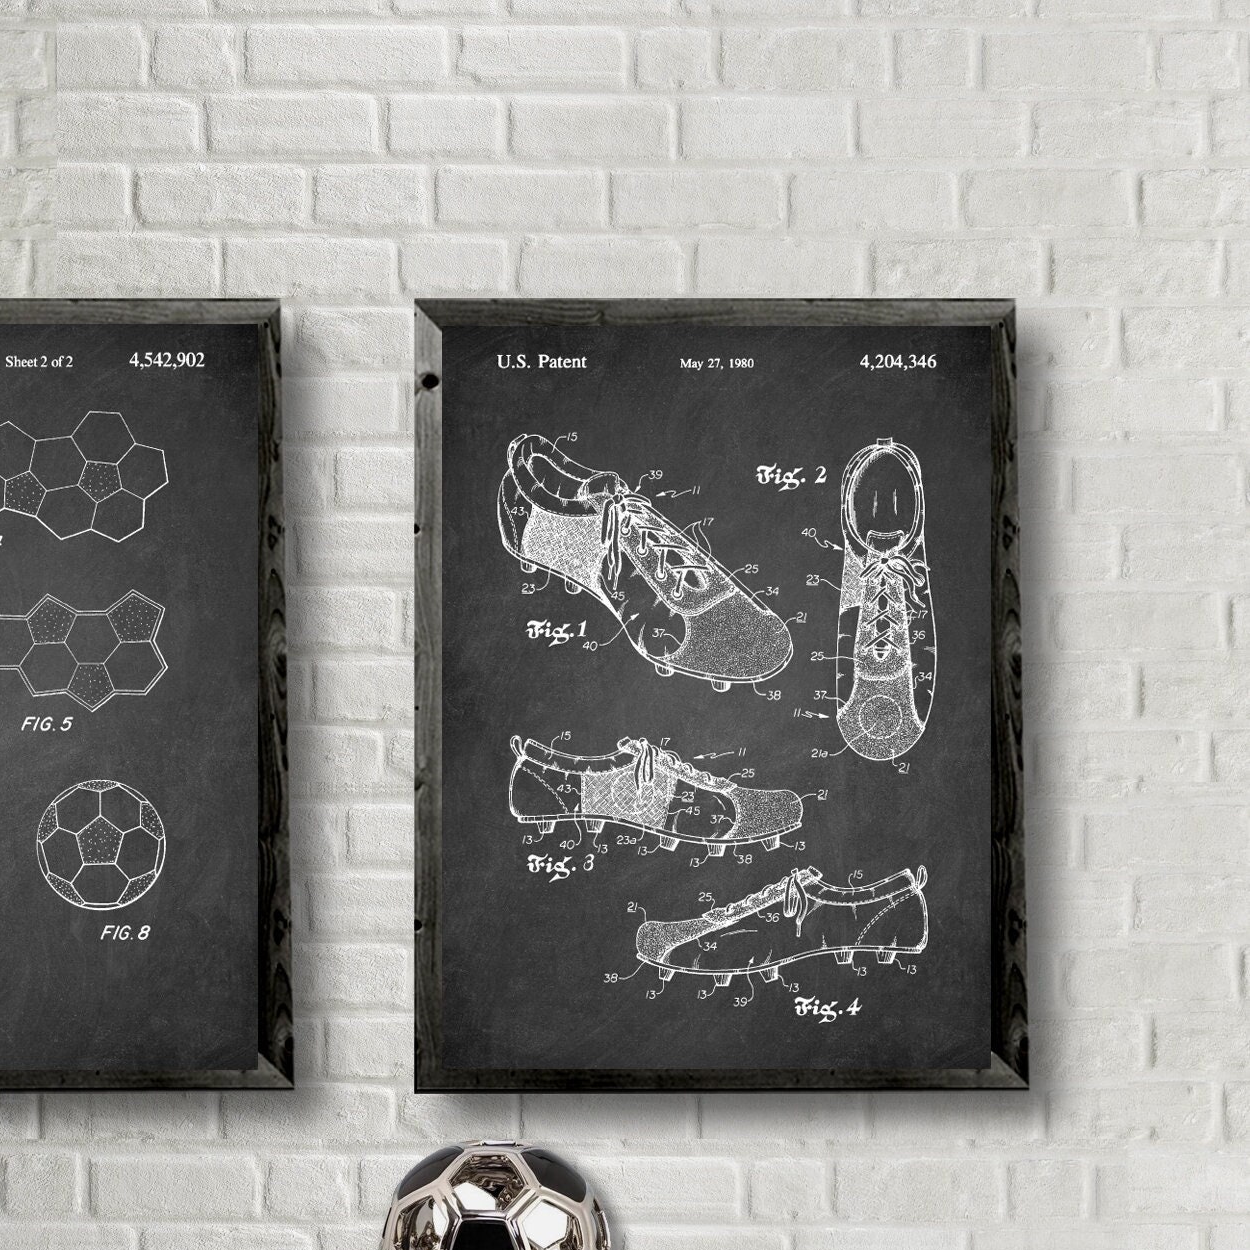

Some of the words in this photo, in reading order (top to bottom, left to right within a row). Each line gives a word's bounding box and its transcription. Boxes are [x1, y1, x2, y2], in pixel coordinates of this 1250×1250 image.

[5, 355, 38, 368] Sheet
[40, 355, 48, 368] 2
[51, 355, 63, 368] of
[64, 356, 74, 368] 2
[129, 352, 205, 370] 4,542,902
[497, 354, 532, 369] U.S.
[538, 354, 588, 370] Patent
[680, 358, 704, 371] May
[707, 358, 725, 371] 27,
[729, 358, 755, 369] 1980
[859, 353, 938, 371] 4,204,346
[567, 432, 578, 442] 15
[648, 469, 664, 480] 39
[814, 465, 828, 485] 2
[510, 506, 525, 516] 43
[801, 527, 817, 538] 40
[744, 563, 760, 574] 25
[806, 574, 820, 586] 23
[521, 583, 536, 594] 23
[765, 587, 780, 597] 34
[610, 591, 626, 601] 45
[651, 628, 665, 638] 37
[911, 630, 927, 640] 36
[582, 641, 599, 652] 40
[810, 651, 825, 661] 25
[917, 671, 933, 682] 34
[766, 690, 782, 701] 38
[813, 690, 828, 701] 37
[20, 716, 56, 732] FIG.
[59, 716, 74, 732] 5
[560, 730, 573, 741] 15
[741, 769, 756, 778] 25
[898, 762, 911, 774] 21
[556, 784, 573, 794] 43
[681, 791, 695, 802] 23
[685, 806, 701, 816] 45
[709, 815, 724, 825] 37
[521, 835, 534, 845] 13
[559, 839, 576, 850] 40
[794, 840, 807, 851] 13
[596, 844, 609, 855] 13
[582, 853, 596, 872] 3
[736, 854, 753, 865] 38
[853, 869, 864, 880] 15
[698, 892, 713, 903] 25
[765, 912, 781, 923] 36
[100, 924, 135, 941] FIG.
[137, 924, 151, 941] 8
[702, 941, 718, 952] 34
[906, 964, 918, 975] 13
[603, 973, 619, 984] 38
[788, 982, 800, 993] 13
[645, 990, 657, 1000] 13
[733, 996, 749, 1007] 39
[846, 997, 863, 1016] 4
